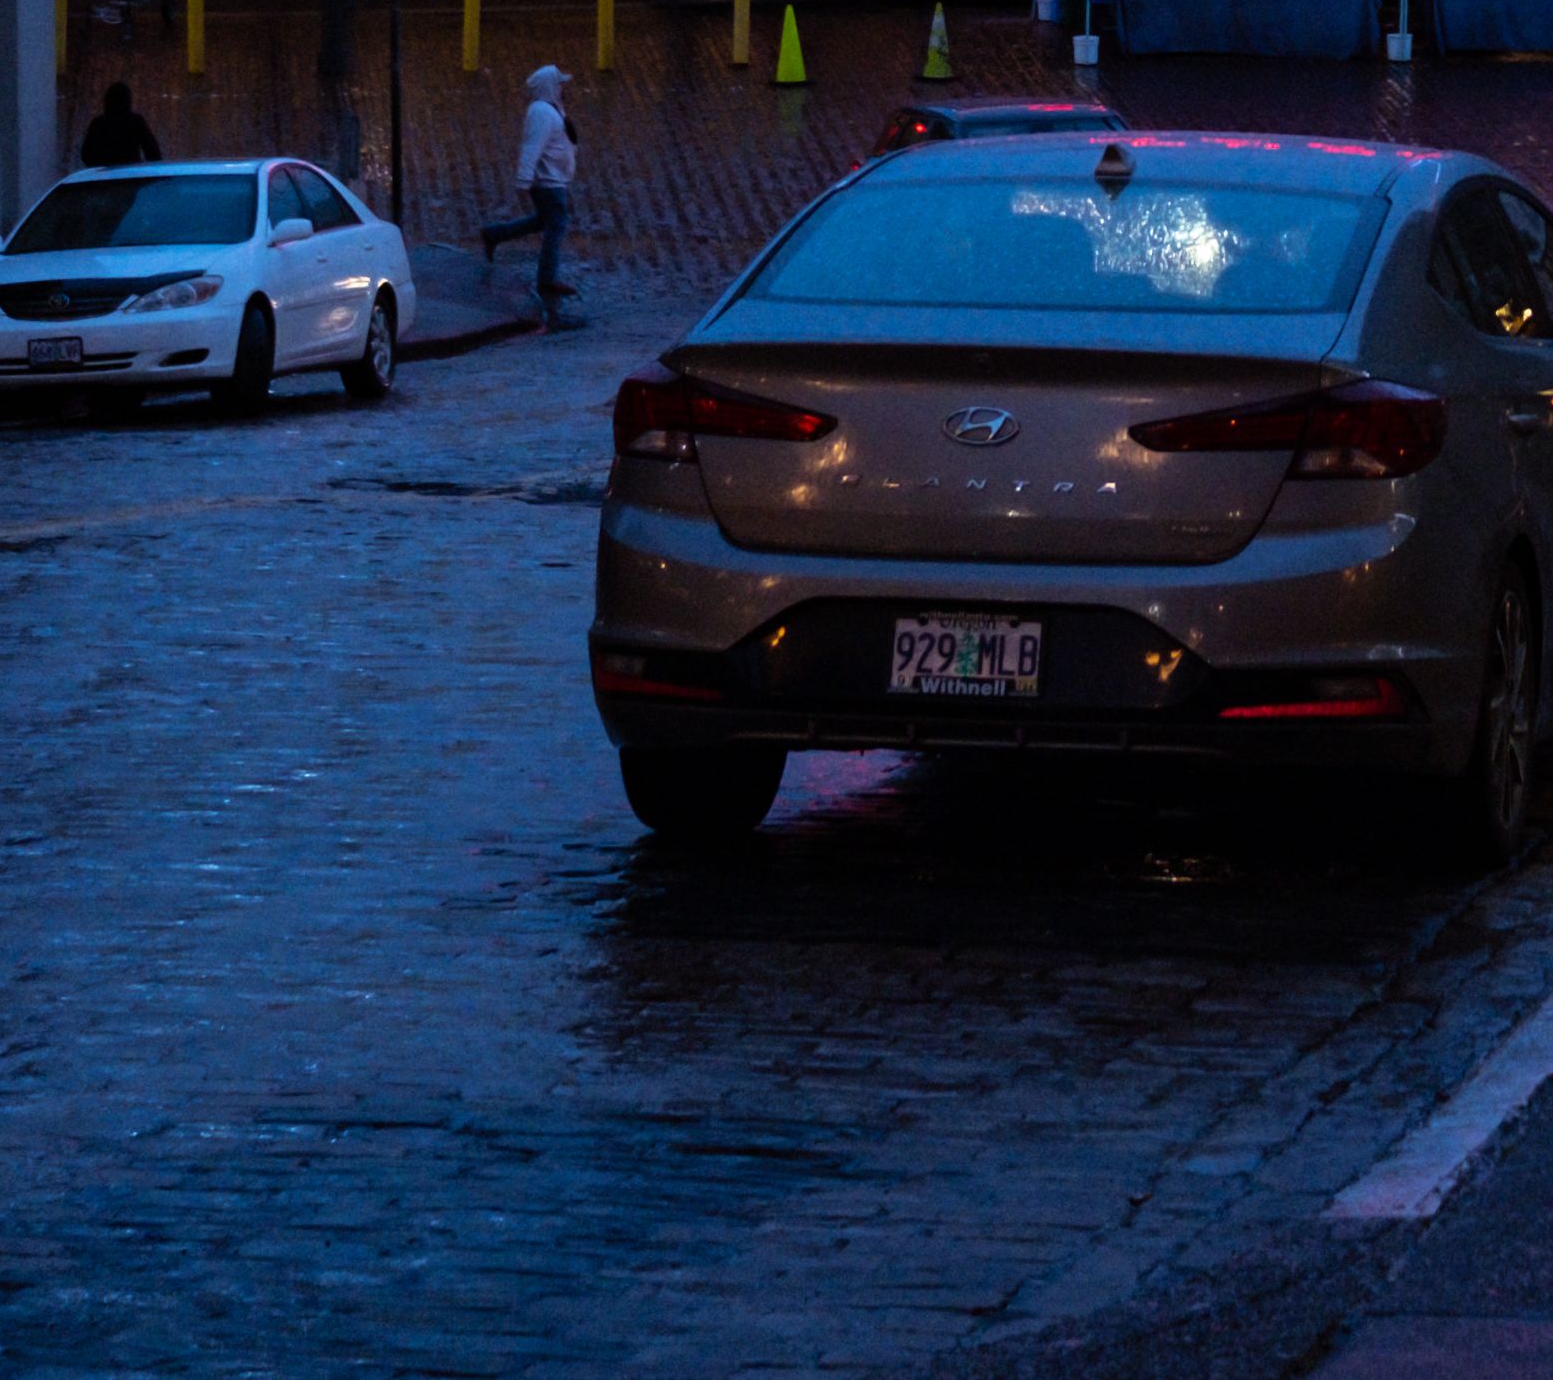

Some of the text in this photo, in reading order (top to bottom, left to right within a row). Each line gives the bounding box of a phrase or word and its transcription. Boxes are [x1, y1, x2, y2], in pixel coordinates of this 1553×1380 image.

[897, 632, 1038, 676] 929 MLB
[921, 677, 1006, 696] Withnell
